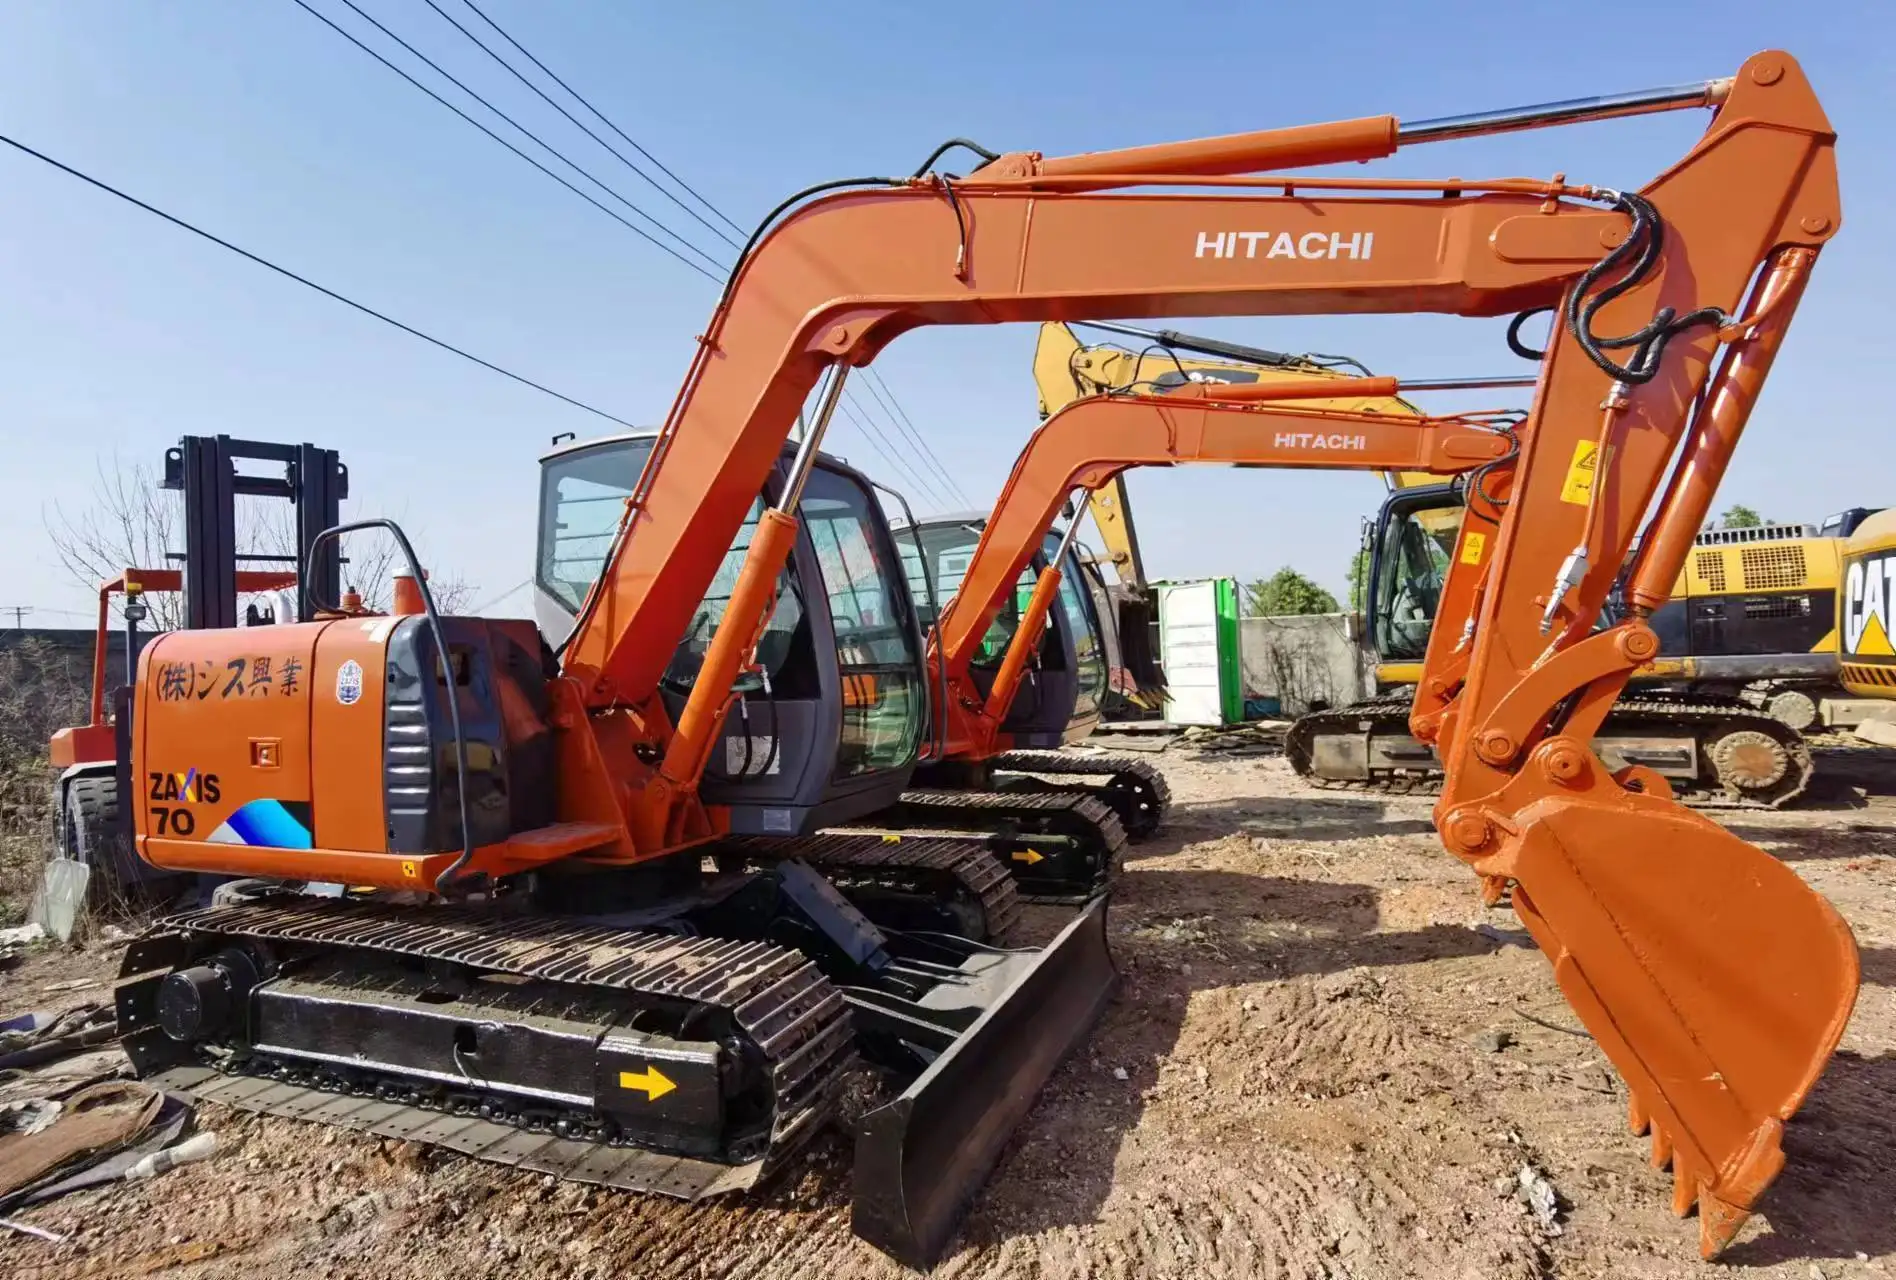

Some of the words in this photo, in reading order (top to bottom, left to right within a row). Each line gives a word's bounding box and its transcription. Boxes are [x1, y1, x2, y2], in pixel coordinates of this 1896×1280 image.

[1195, 231, 1374, 260] HITACHI
[1274, 432, 1366, 450] HITACHI
[150, 767, 221, 804] ZAXIS
[151, 807, 195, 836] 70
